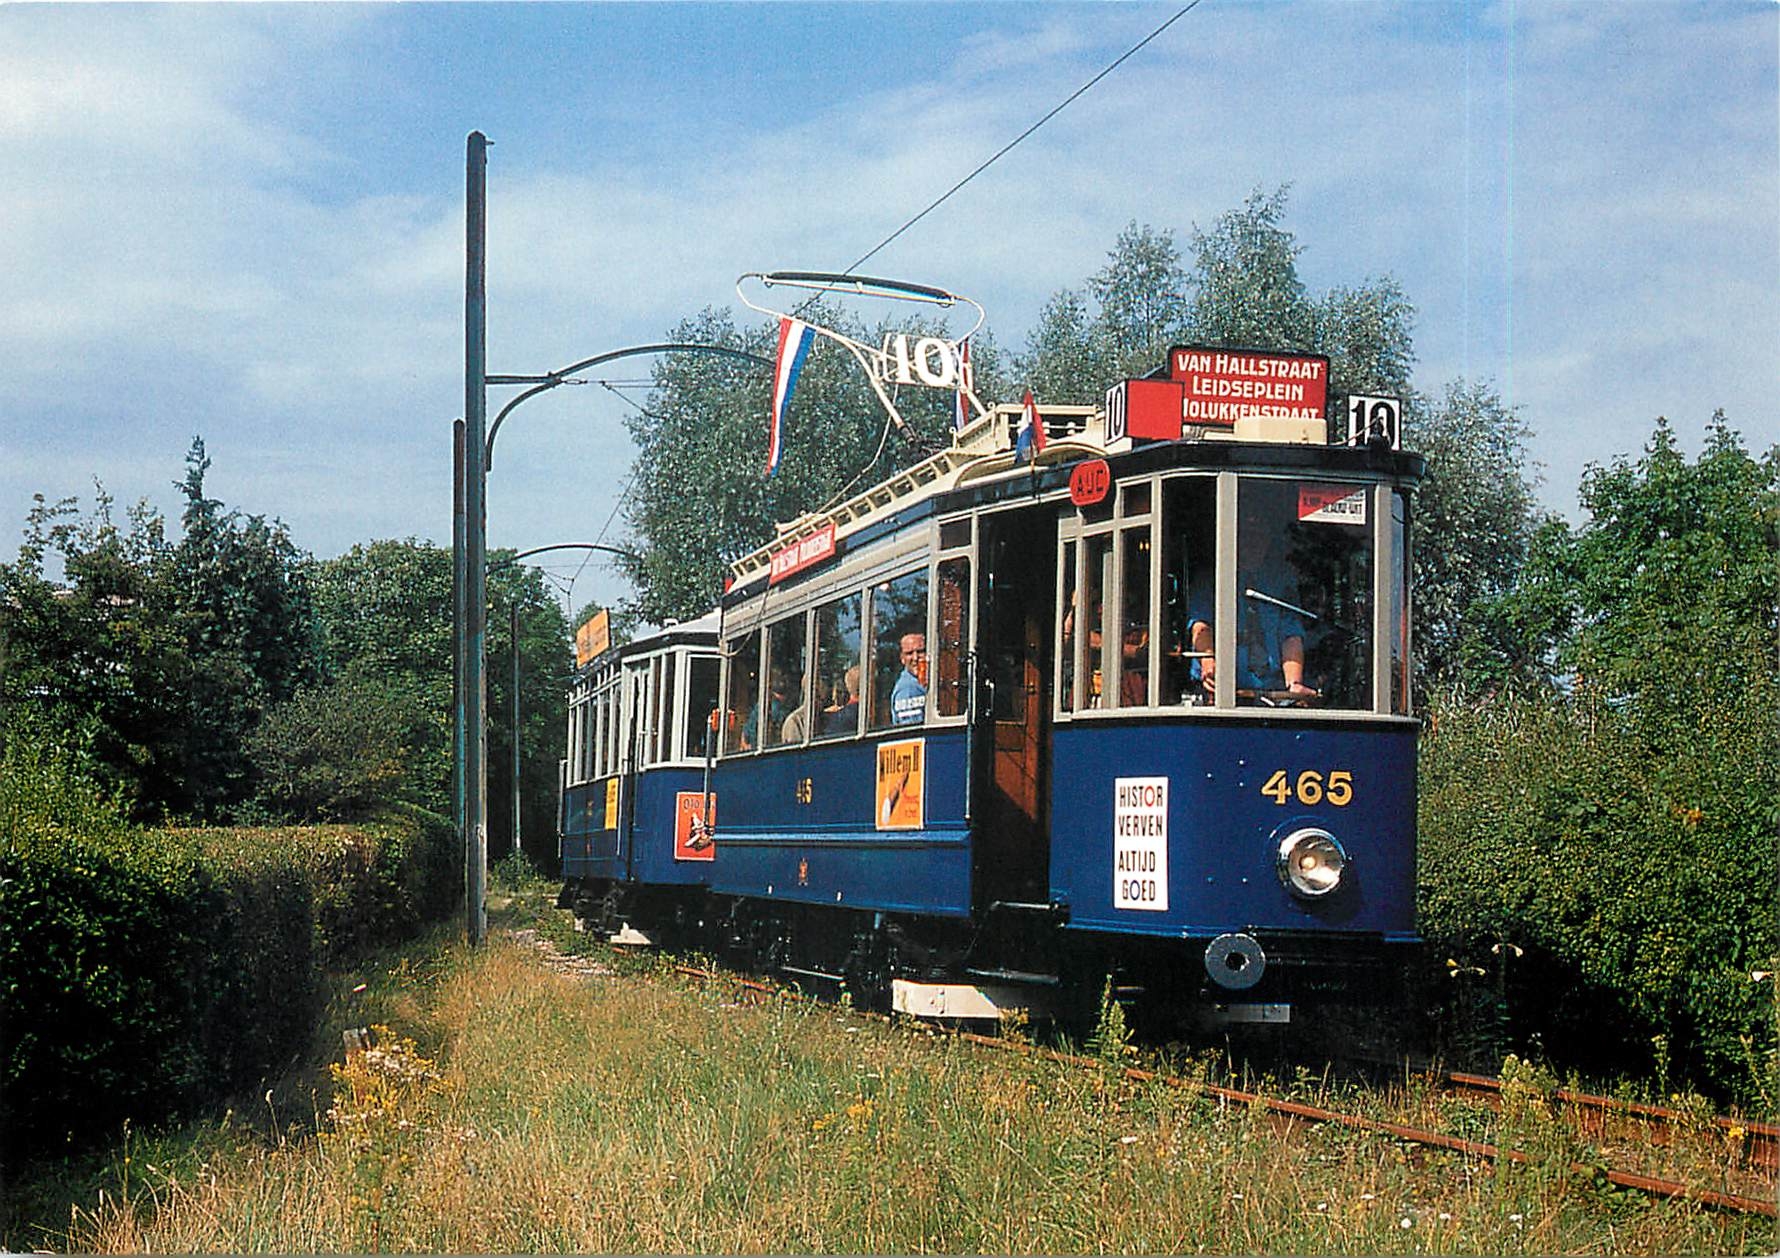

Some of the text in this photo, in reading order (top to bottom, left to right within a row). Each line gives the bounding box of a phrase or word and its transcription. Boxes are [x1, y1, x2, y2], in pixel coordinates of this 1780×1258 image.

[892, 333, 954, 388] 10
[1178, 354, 1322, 380] VAN HALLSTRAAT
[1192, 375, 1304, 401] LEIDSEPLEIN
[1106, 386, 1123, 441] 10
[1183, 398, 1320, 420] OLUKKENSTRAAT
[1350, 399, 1396, 449] 10
[1119, 785, 1163, 808] HISTOR
[1261, 769, 1354, 807] 465
[1118, 815, 1163, 837] VERVEN
[1118, 850, 1156, 873] ALTIJD
[1122, 879, 1156, 902] GOED
